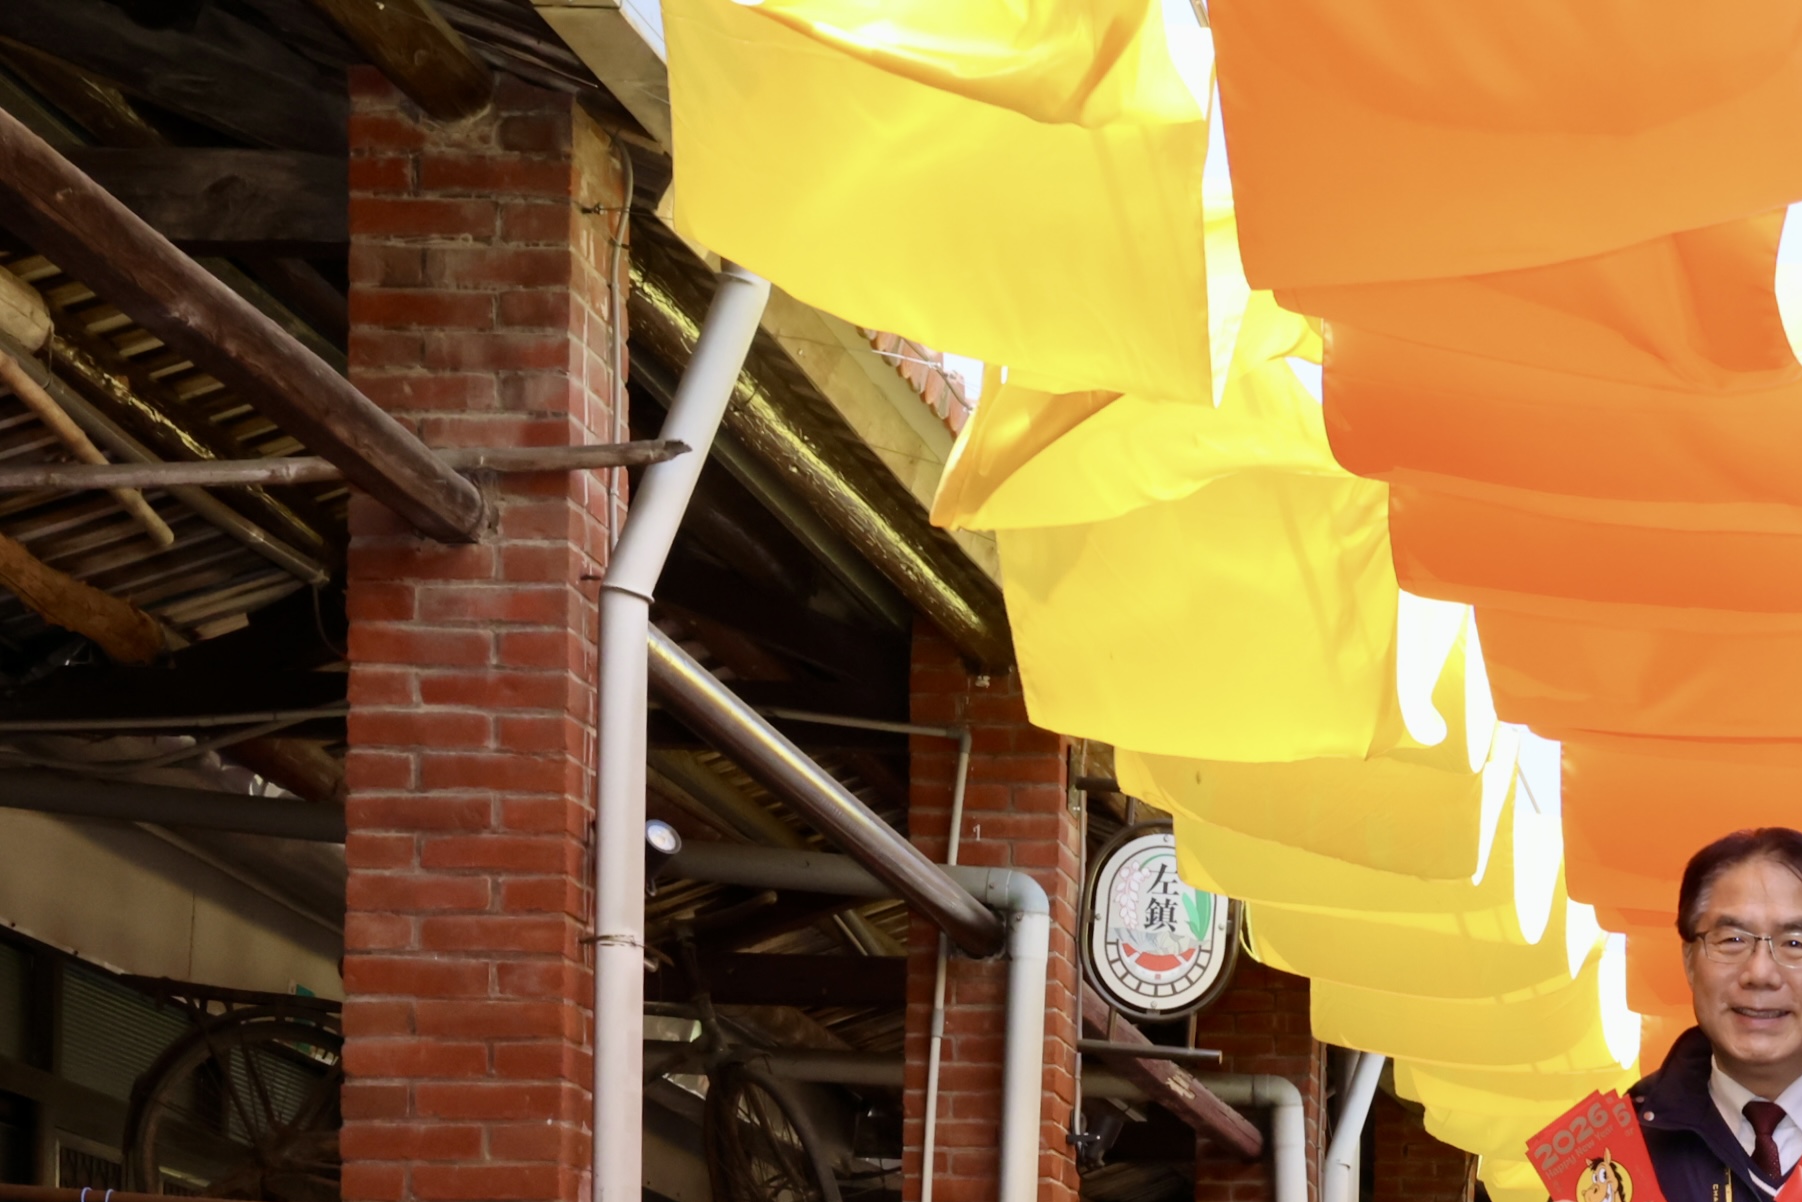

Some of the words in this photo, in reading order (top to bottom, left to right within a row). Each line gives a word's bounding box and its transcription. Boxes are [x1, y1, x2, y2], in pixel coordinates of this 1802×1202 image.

[1144, 863, 1180, 932] 左鎮
[1533, 1101, 1609, 1170] 2026
[1545, 1155, 1577, 1180] Happy
[1574, 1140, 1596, 1157] New
